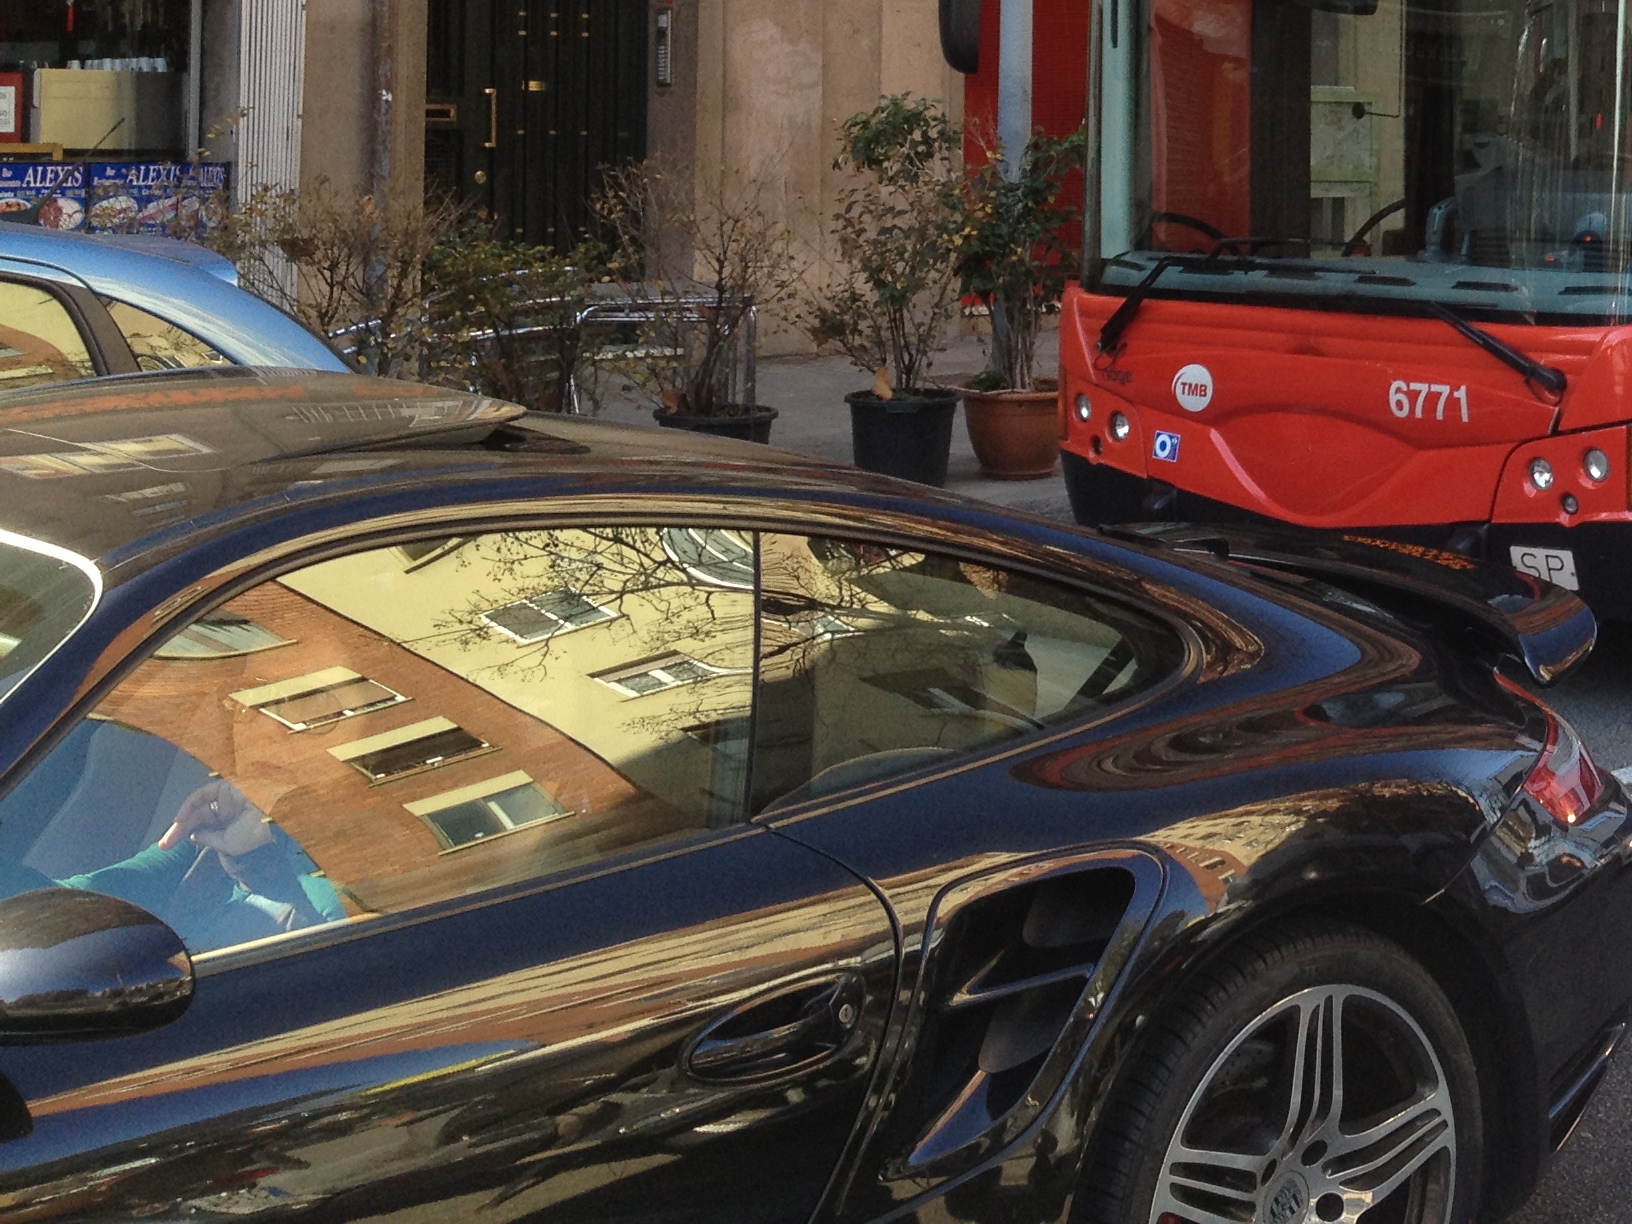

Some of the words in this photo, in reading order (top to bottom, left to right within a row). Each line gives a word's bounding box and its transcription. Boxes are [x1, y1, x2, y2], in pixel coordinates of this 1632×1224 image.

[1180, 381, 1207, 399] TMB
[1389, 380, 1469, 423] 6771
[1520, 552, 1564, 583] SP
